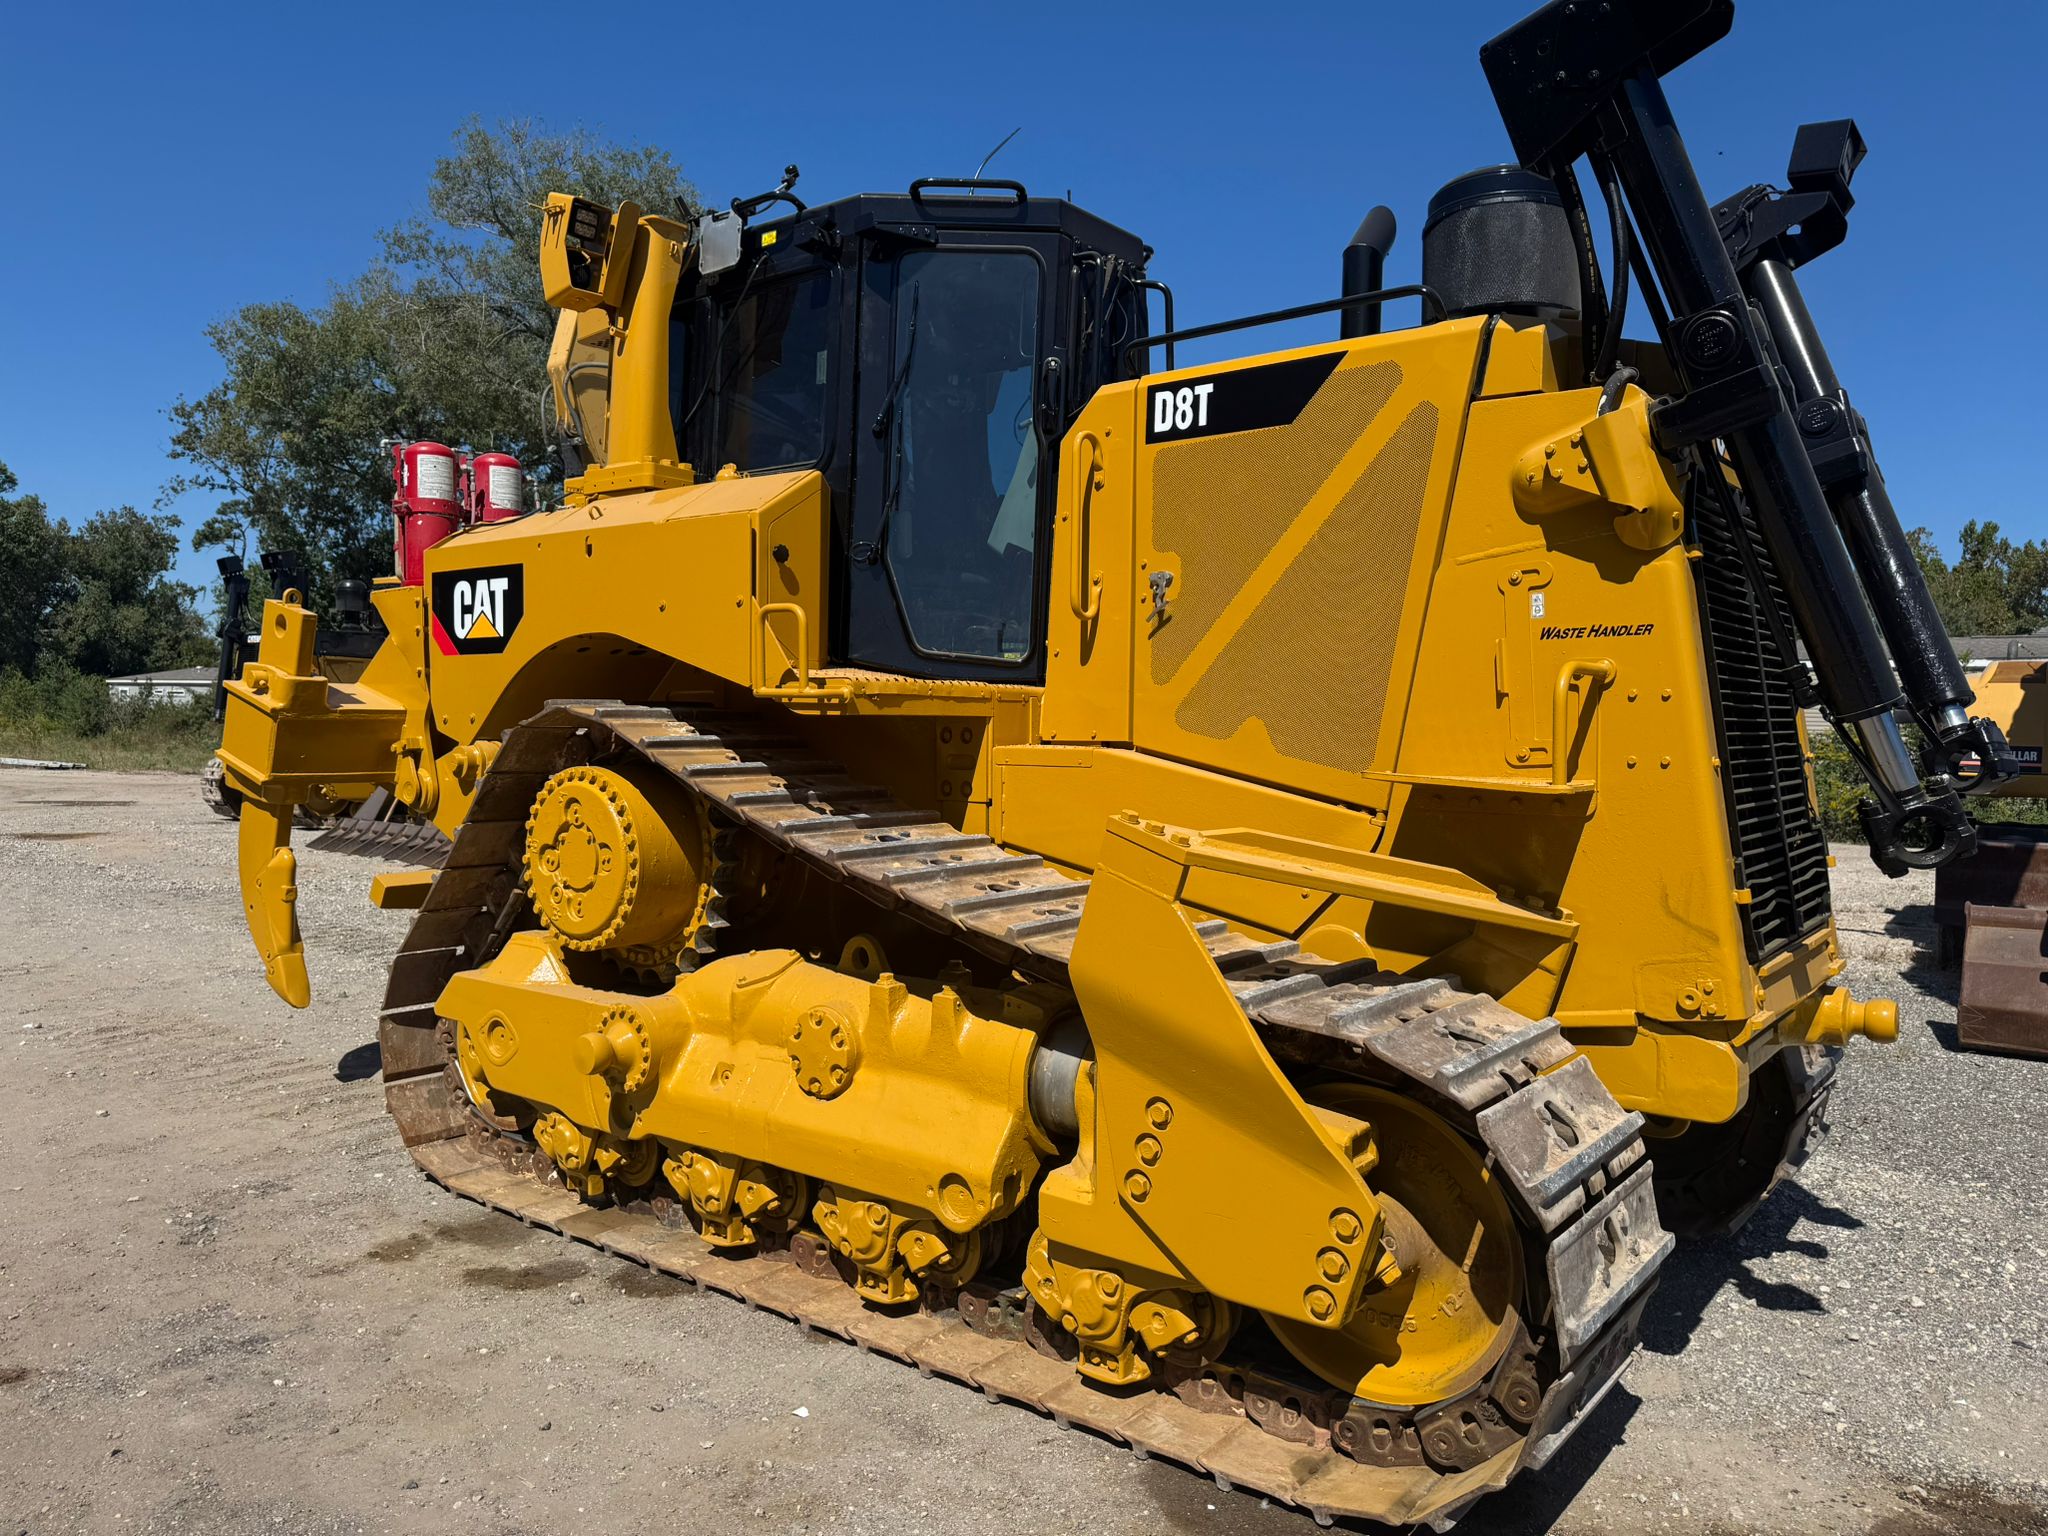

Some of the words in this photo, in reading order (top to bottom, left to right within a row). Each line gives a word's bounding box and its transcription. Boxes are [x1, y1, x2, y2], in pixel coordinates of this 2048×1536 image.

[1153, 383, 1214, 433] D8T
[453, 577, 509, 640] CAT
[1539, 627, 1587, 641] WASTE
[1587, 623, 1655, 638] HANDLER
